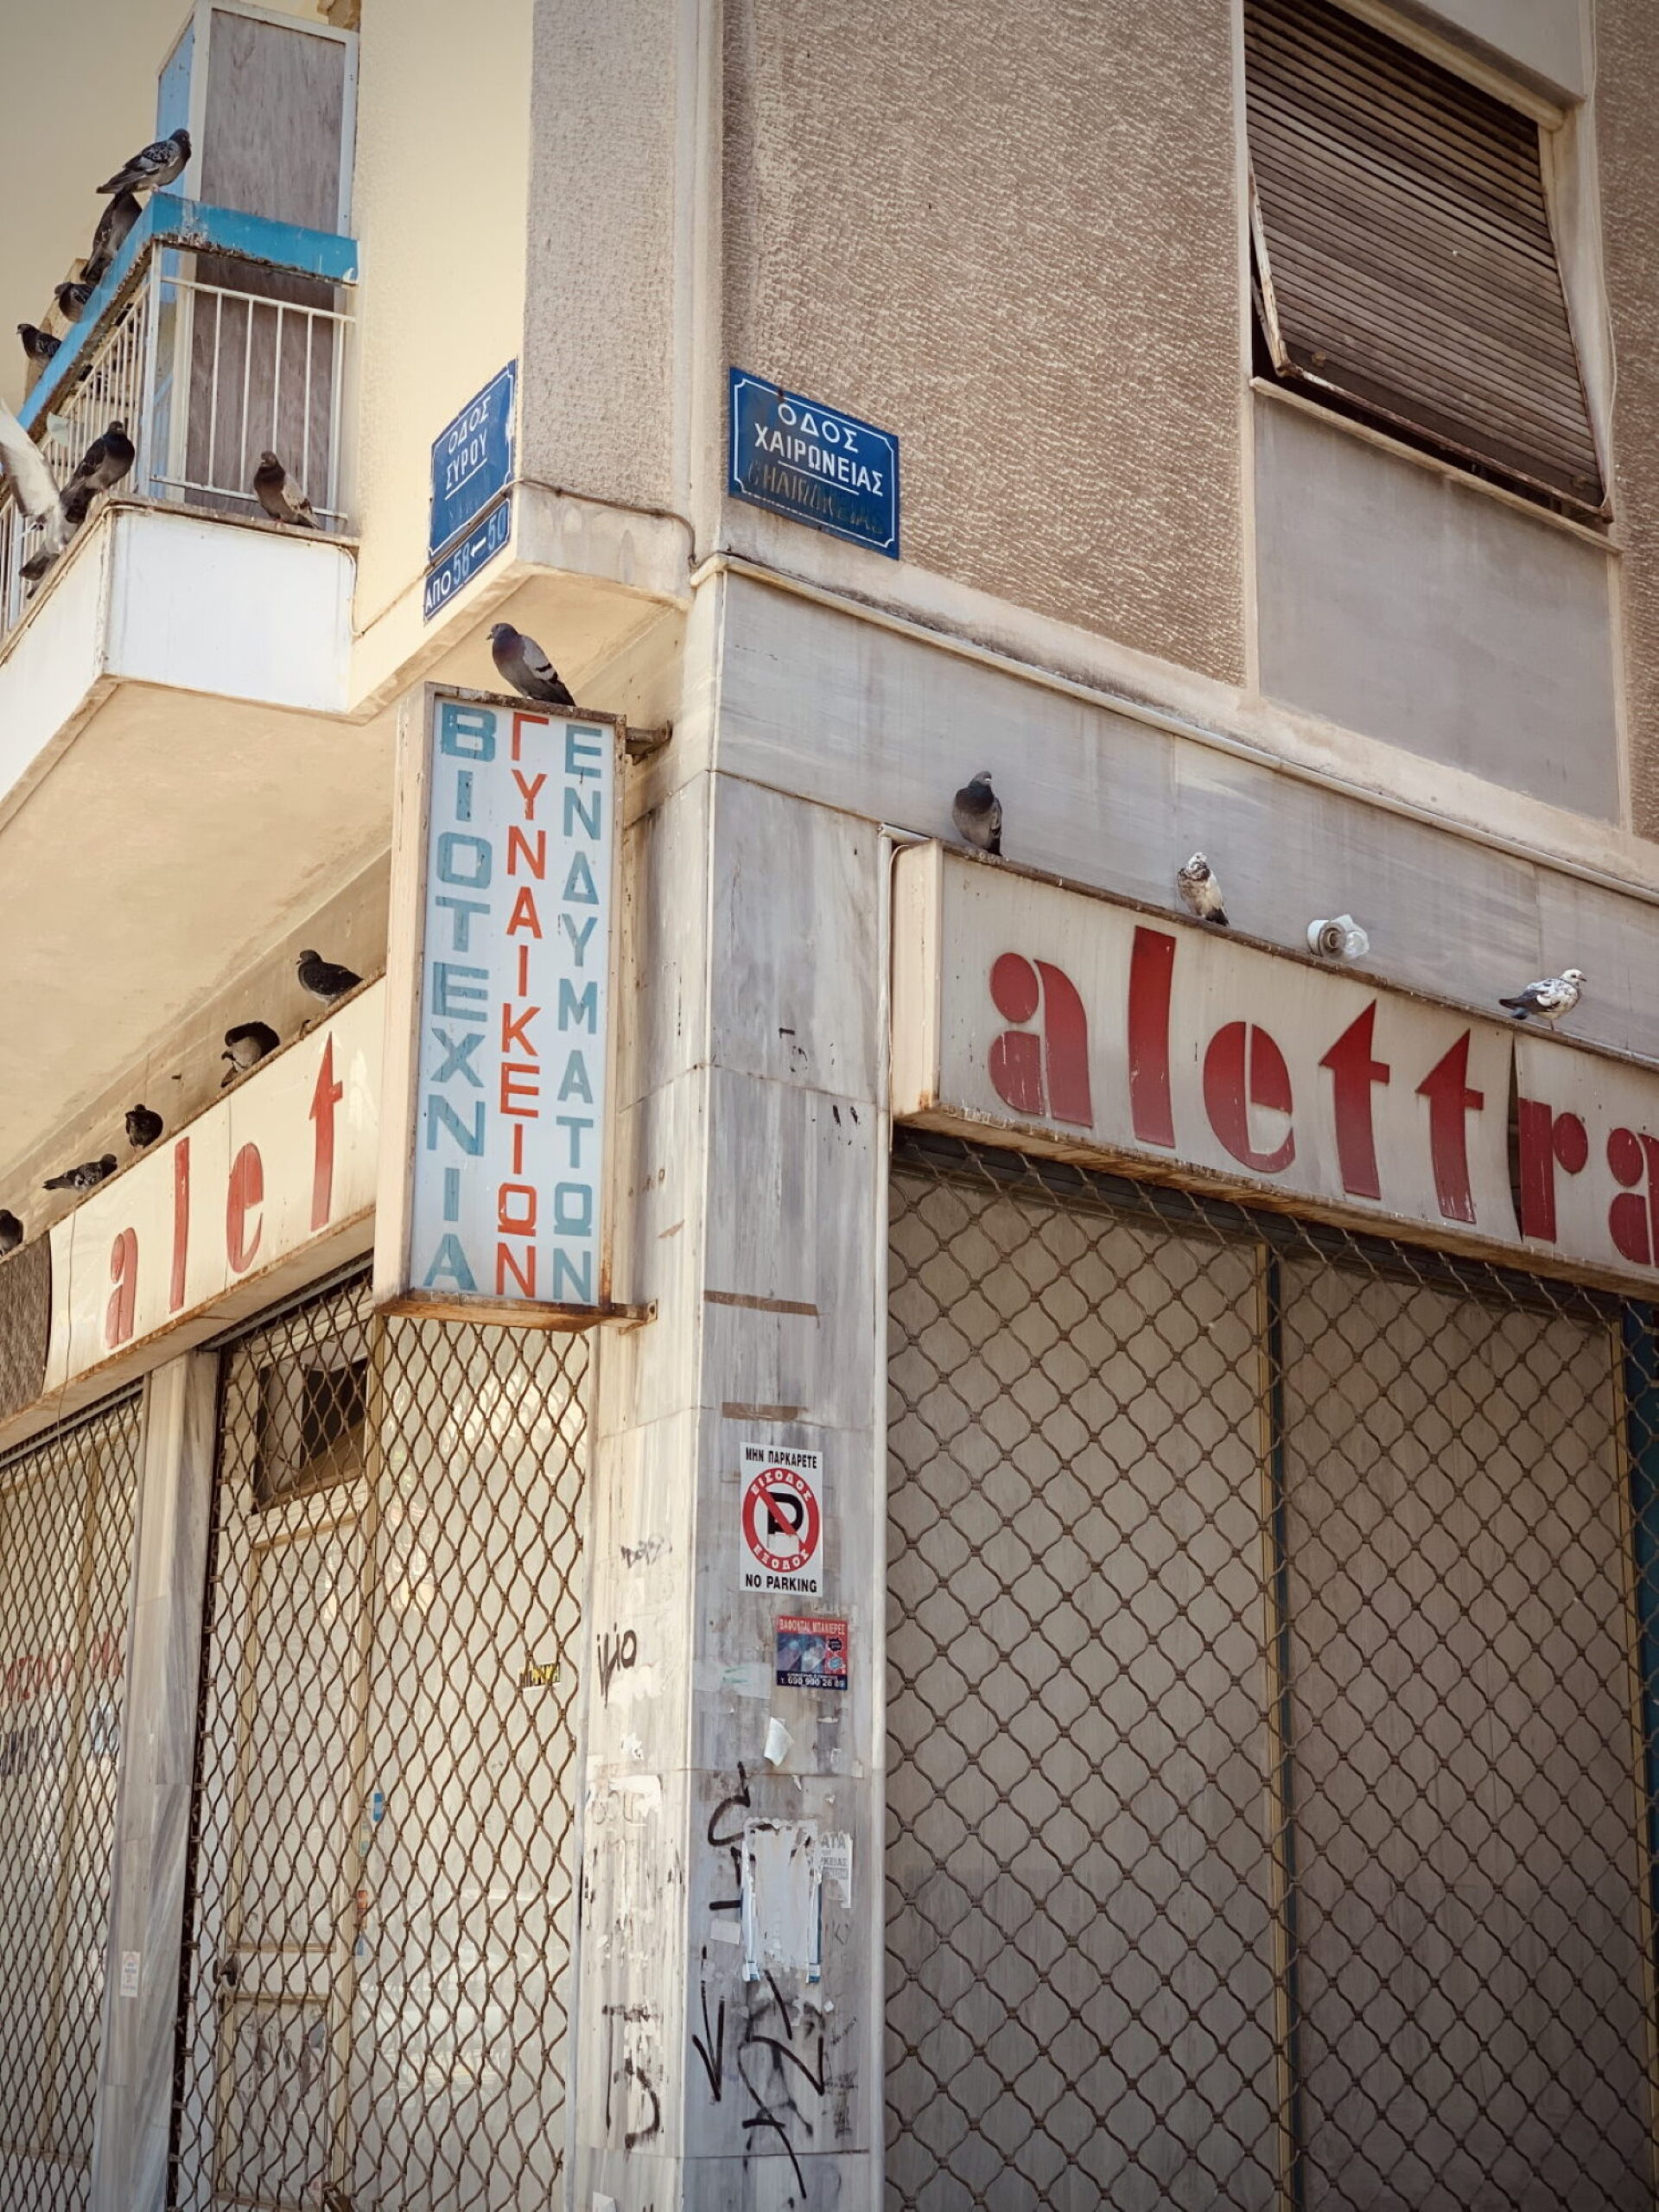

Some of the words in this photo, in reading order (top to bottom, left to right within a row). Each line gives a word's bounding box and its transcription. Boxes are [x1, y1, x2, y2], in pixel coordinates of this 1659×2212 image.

[448, 395, 491, 454] ΟΔΟΣ
[778, 403, 859, 453] ΟΔΟΣ
[446, 429, 487, 491] ΣΥΡΟΥ
[754, 423, 884, 497] ΧΑΙΡΩΝΕΙΑΣ
[425, 569, 451, 613] ΑΠΟ
[452, 541, 470, 585] 58
[487, 507, 507, 552] 50
[423, 702, 498, 1293] ΒΙΟΤΕΧΝΙΑ
[495, 710, 550, 1300] ΓΥΝΑΙΚΕΙΩΝ
[552, 722, 603, 1305] ΕΝΔΥΜΑΤΩΝ
[746, 1446, 764, 1462] ΜΗΝ
[768, 1451, 817, 1469] ΠΑΡΚΑΡΕΤΕ
[746, 1573, 762, 1588] NO
[766, 1575, 817, 1593] PARKING
[753, 1542, 810, 1570] ΕΞΟΔΟΣ
